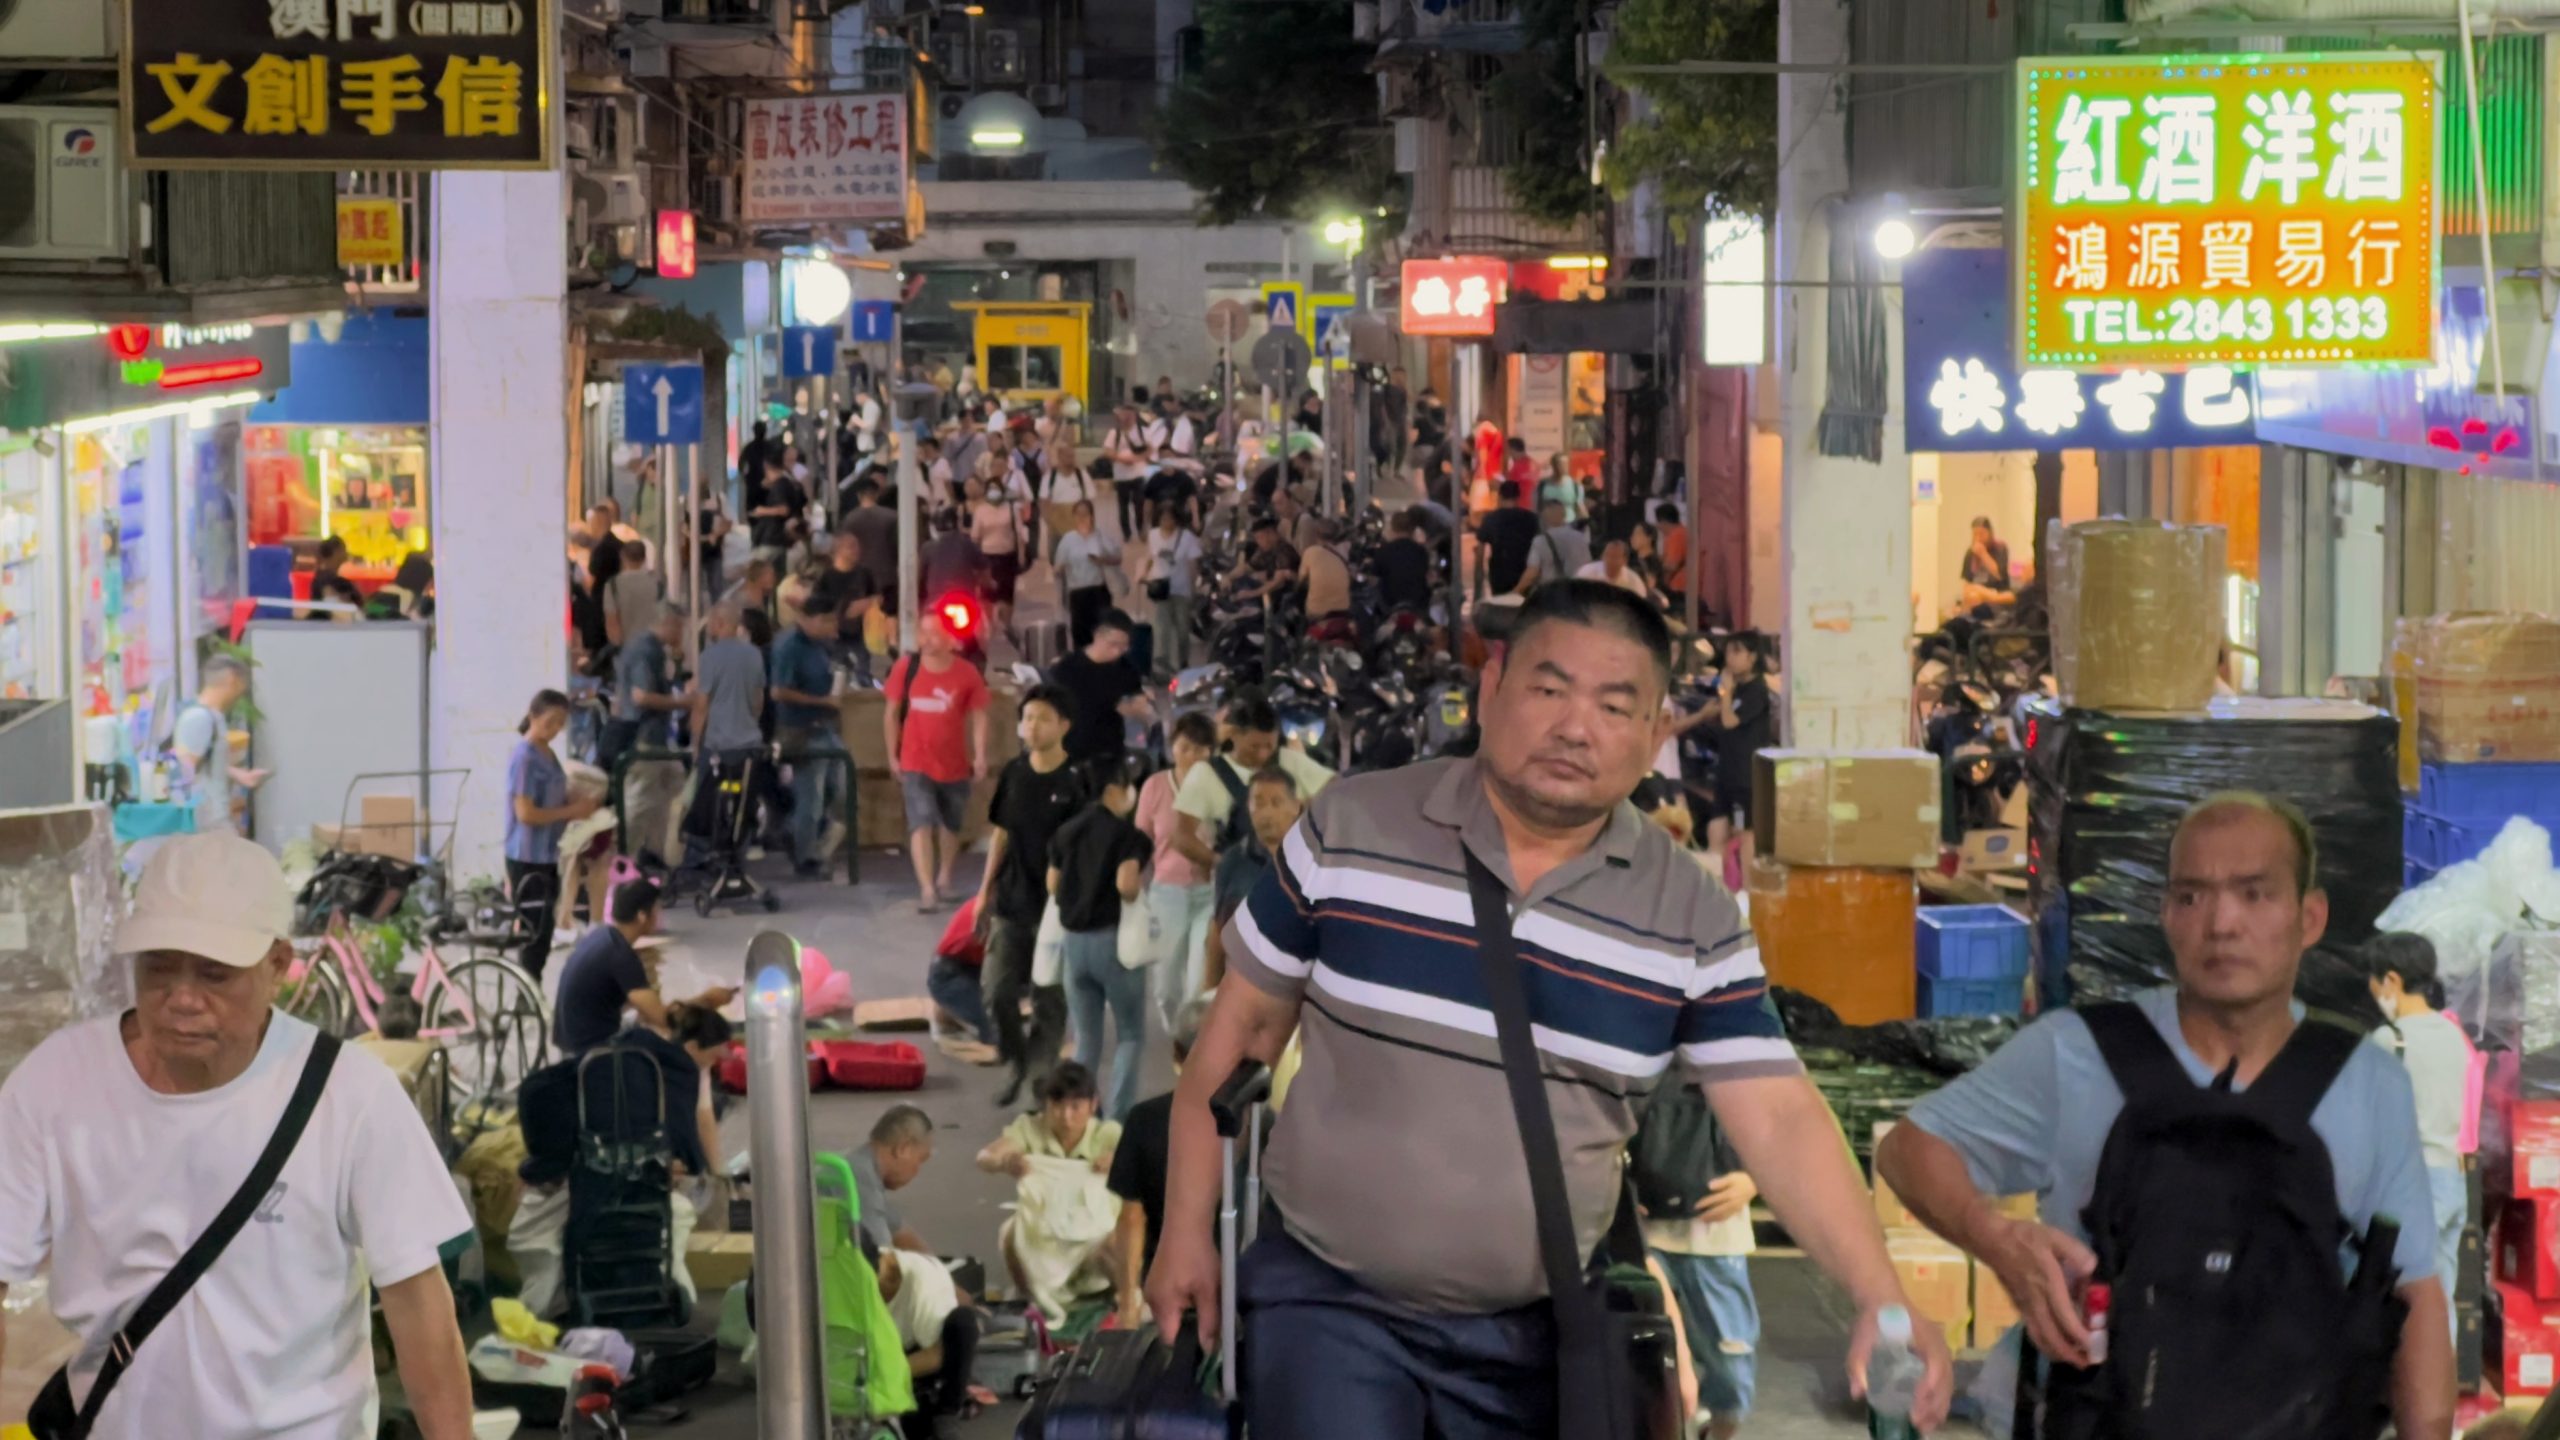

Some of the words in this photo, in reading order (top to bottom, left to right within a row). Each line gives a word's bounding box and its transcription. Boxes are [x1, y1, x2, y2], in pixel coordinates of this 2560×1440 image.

[269, 0, 397, 41] 澳門
[145, 52, 522, 137] 文創手信
[2054, 94, 2216, 203] 紅酒
[2241, 90, 2403, 204] 洋酒
[2054, 219, 2402, 291] 鴻源貿易行
[2065, 298, 2274, 343] TEL:2843
[2284, 296, 2388, 340] 1333
